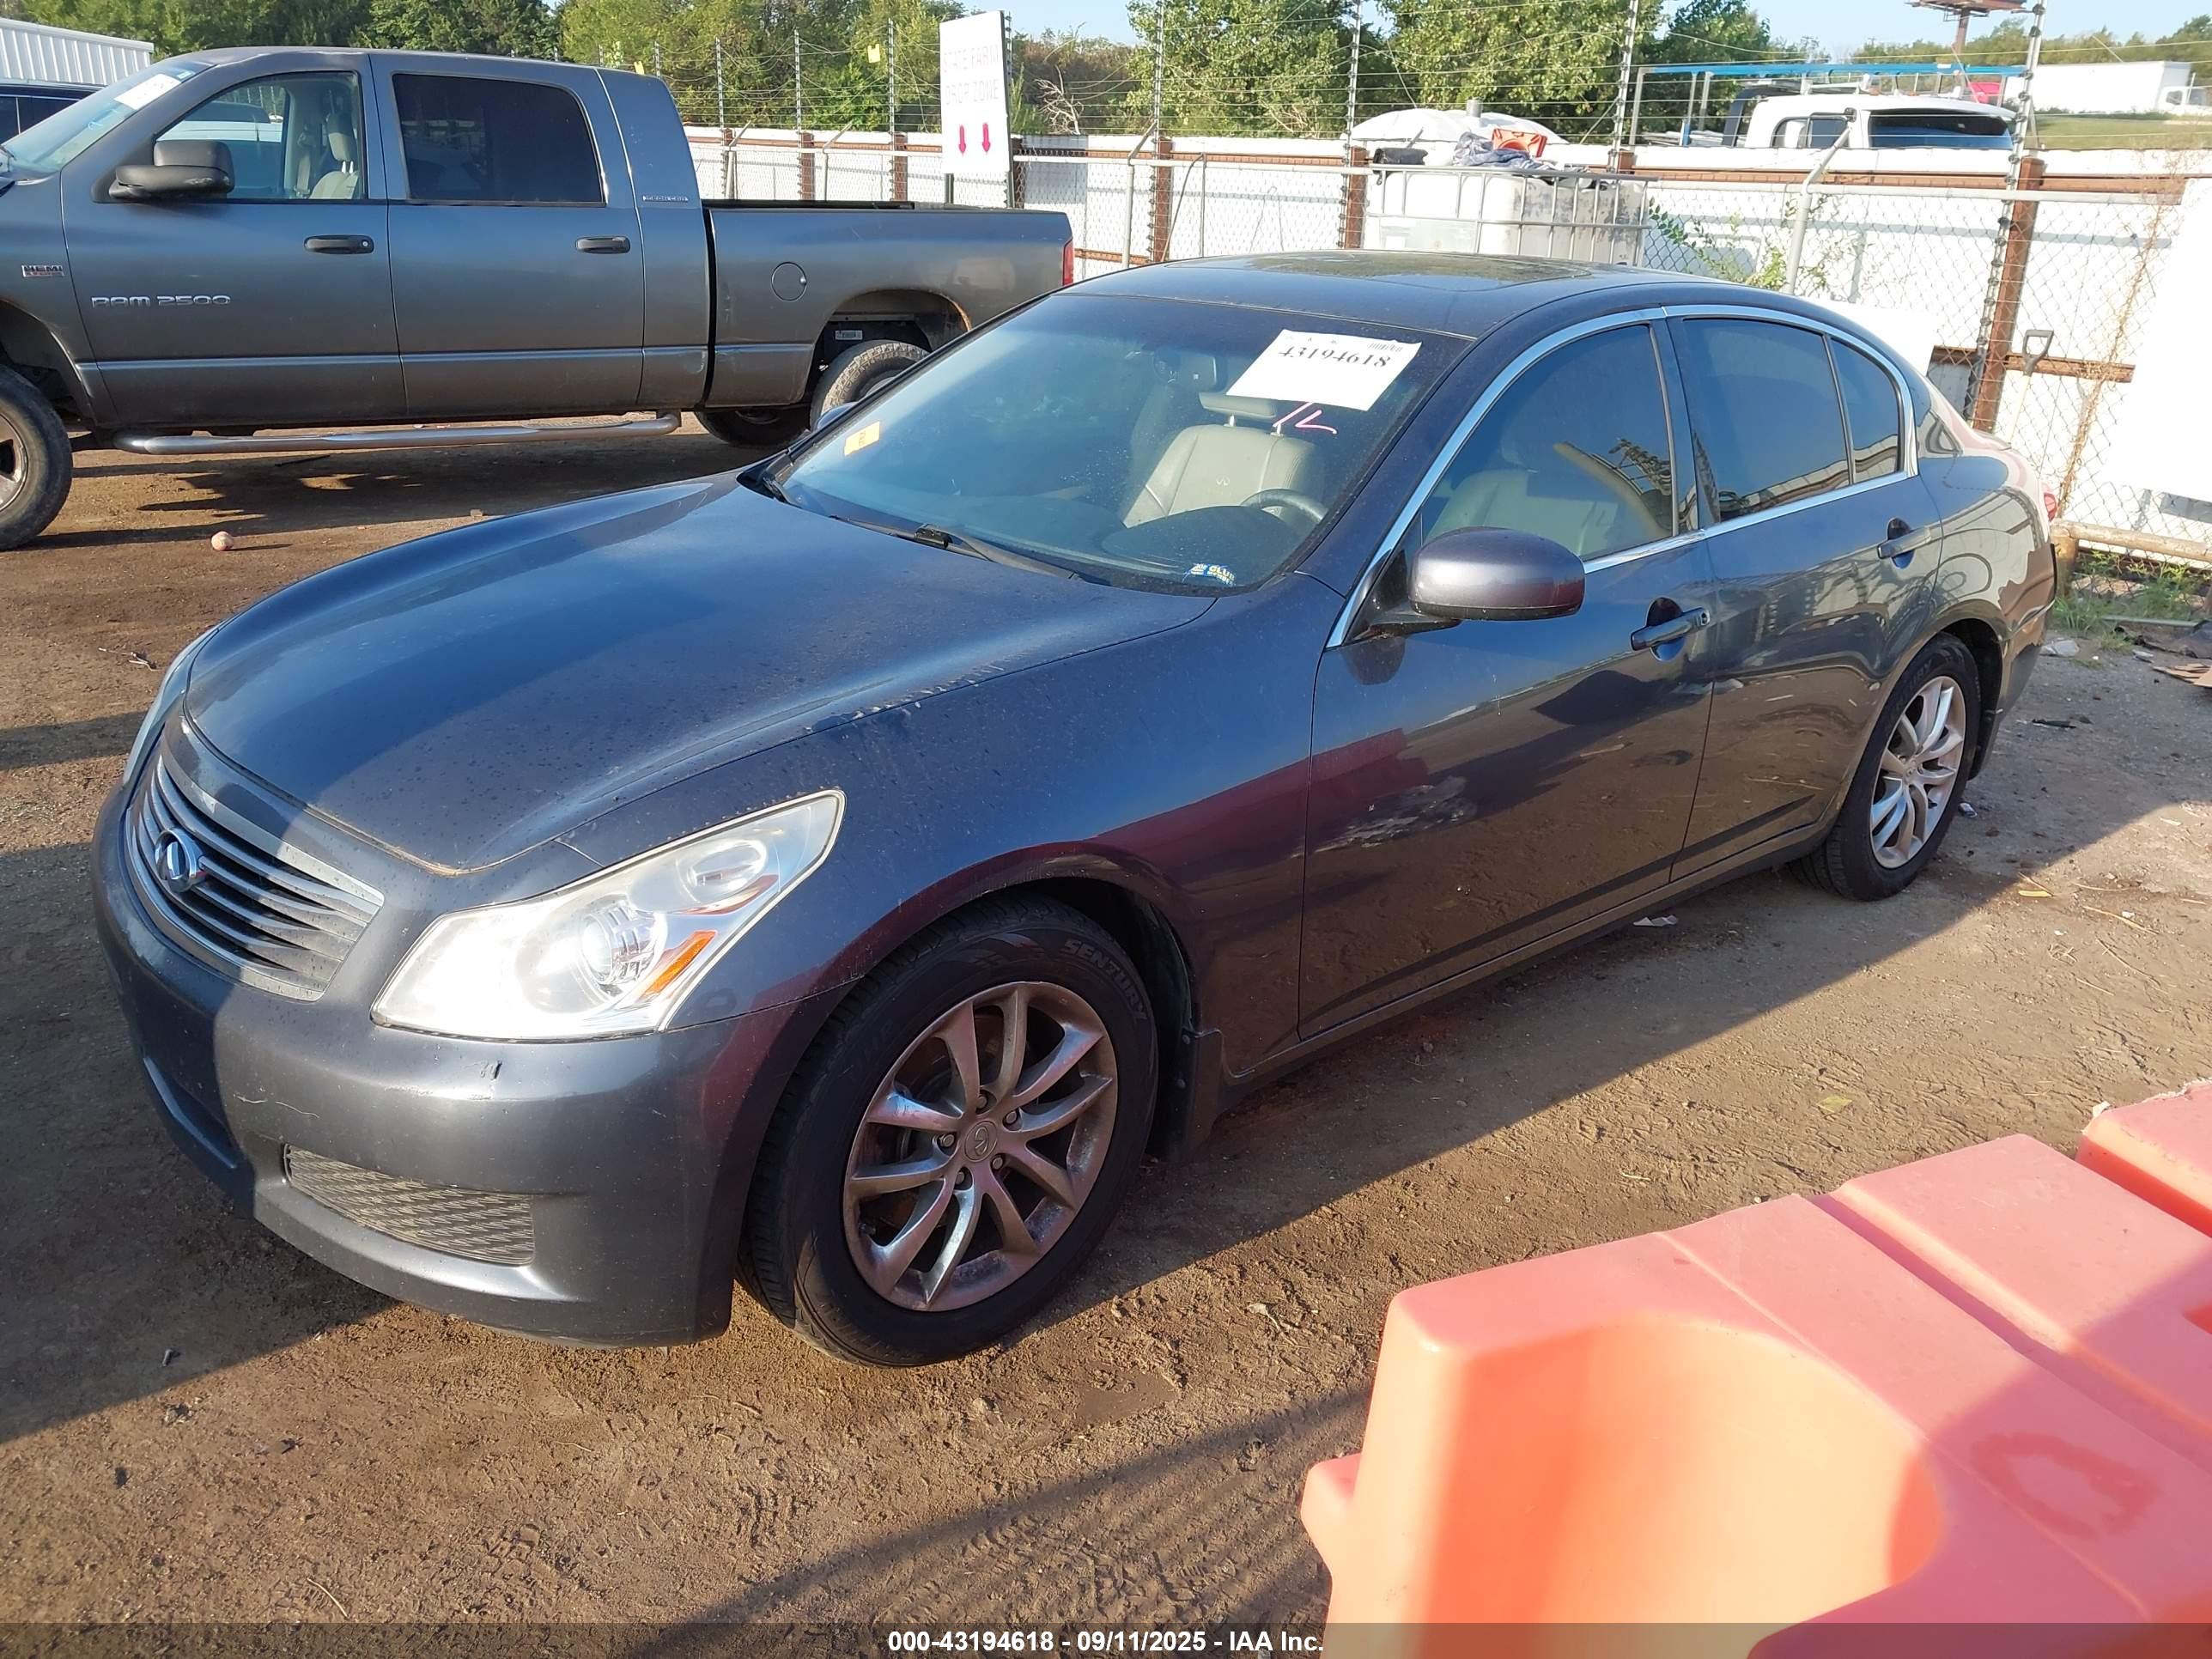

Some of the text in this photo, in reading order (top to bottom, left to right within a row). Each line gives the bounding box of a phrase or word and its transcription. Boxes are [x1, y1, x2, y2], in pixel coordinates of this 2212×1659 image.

[972, 78, 1000, 102] ZONE
[91, 295, 231, 308] RAM 2500
[1278, 345, 1392, 368] 43194618
[1063, 939, 1148, 1023] SENTURY
